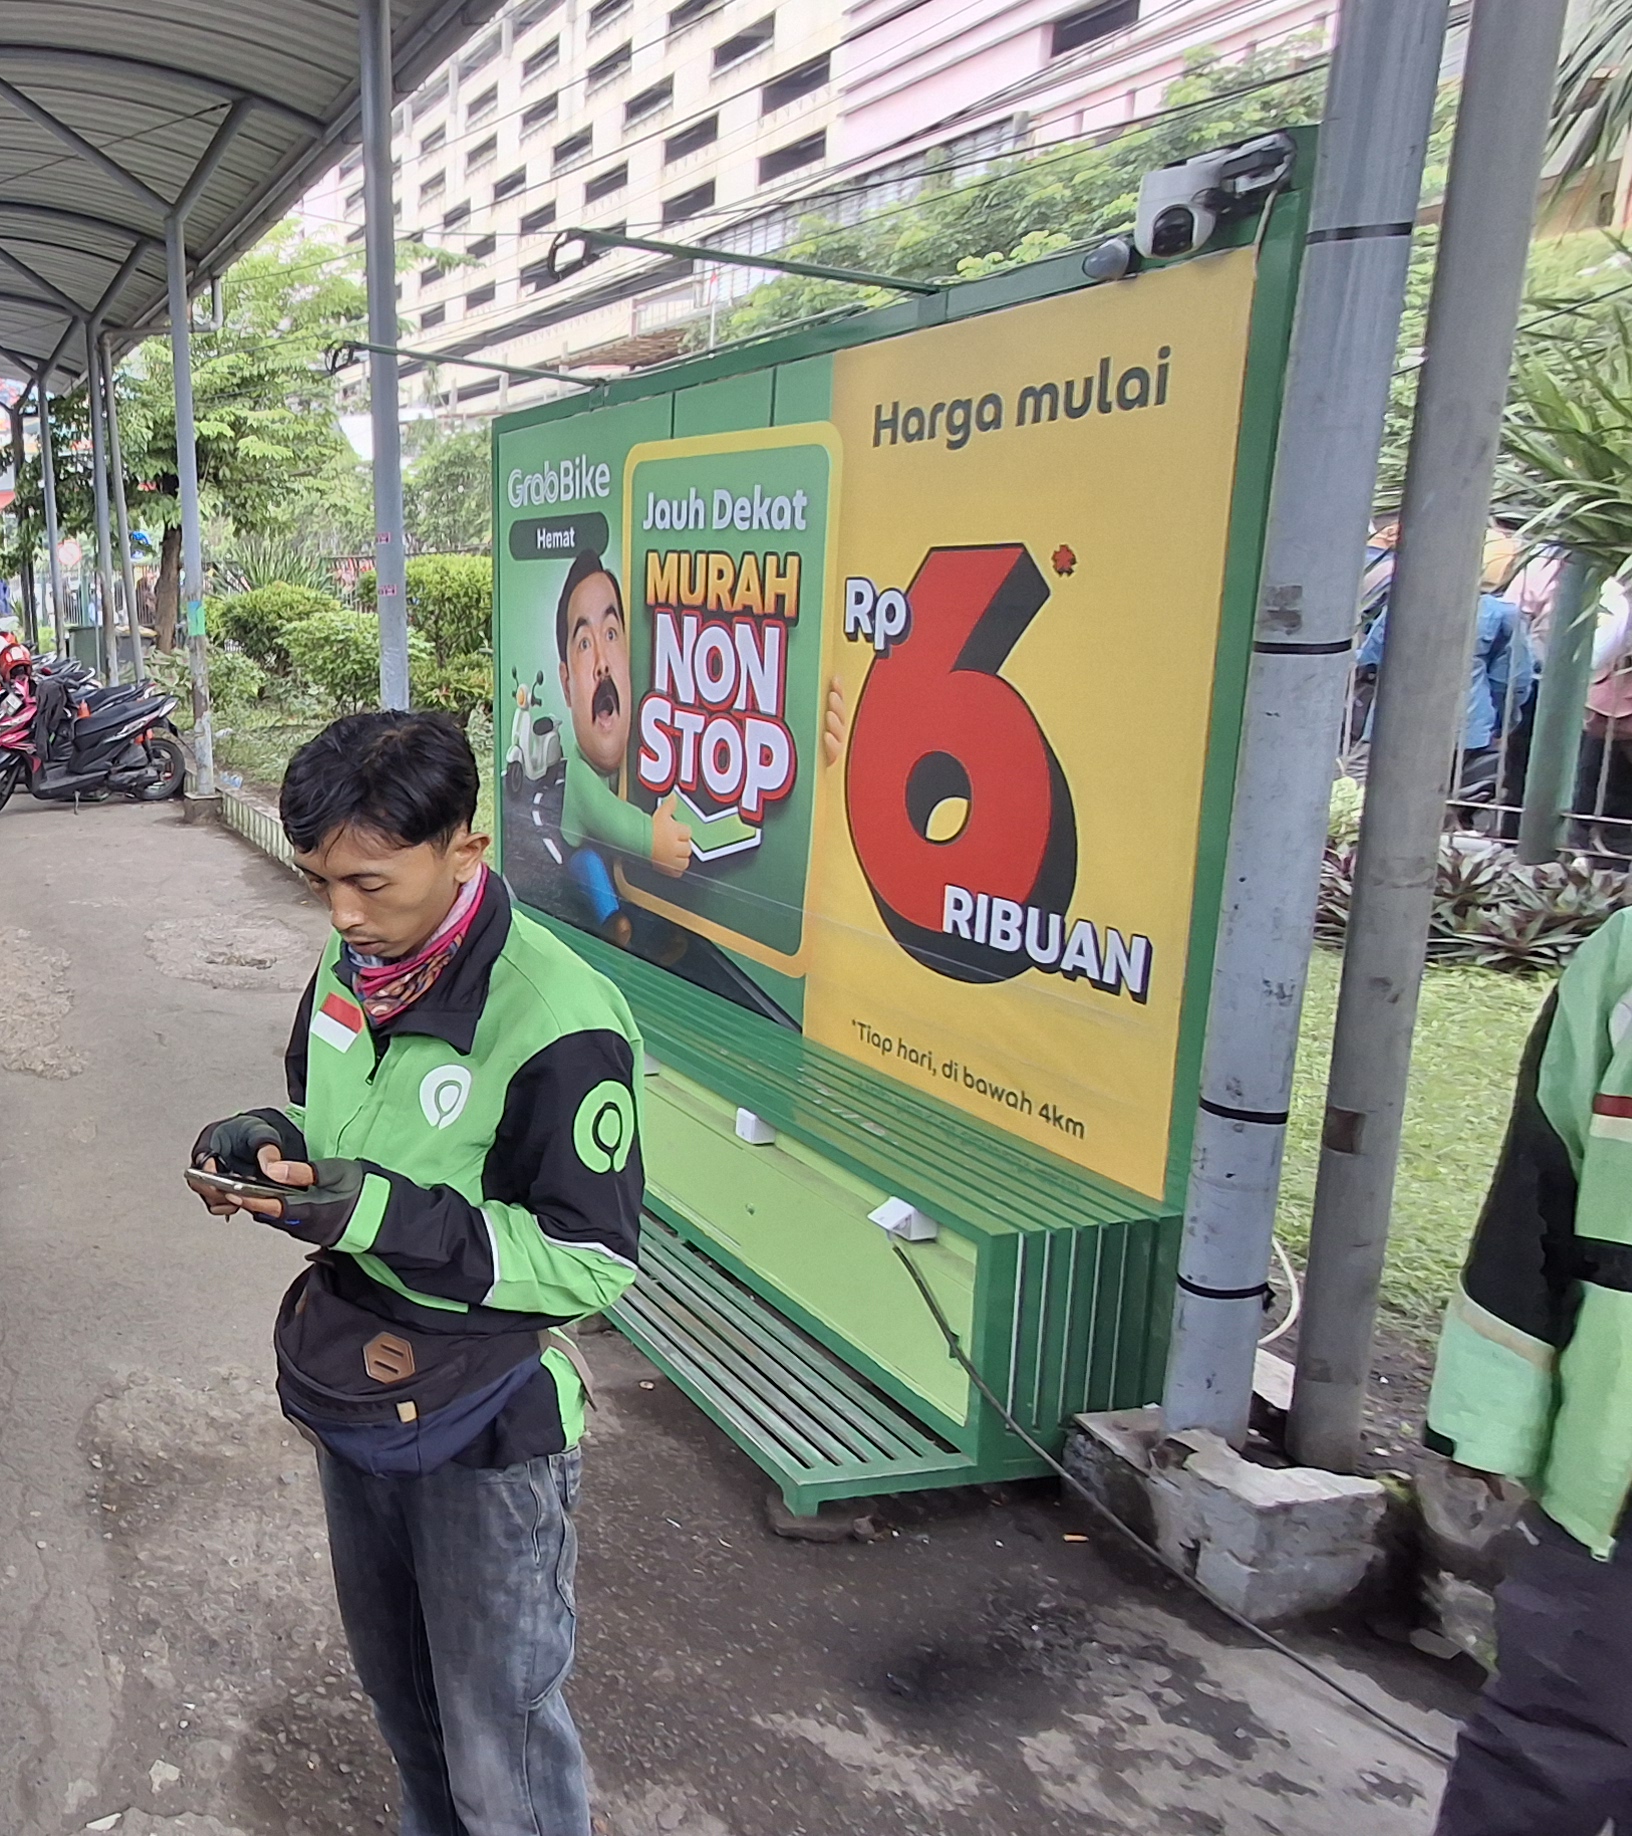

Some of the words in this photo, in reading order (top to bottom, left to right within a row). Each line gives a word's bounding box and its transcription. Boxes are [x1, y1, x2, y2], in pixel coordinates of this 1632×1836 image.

[872, 392, 1003, 451] Harga
[1015, 345, 1172, 428] mulai
[507, 454, 611, 509] GrabBike
[642, 487, 705, 531] Jauh
[712, 484, 808, 531] Dekat
[535, 526, 576, 550] Hemat
[646, 550, 801, 619] MURAH
[653, 611, 785, 717] NON
[844, 577, 910, 652] Rp
[638, 694, 794, 816] STOP
[847, 543, 1074, 981] 6
[942, 884, 1152, 1000] RIBUAN
[896, 1037, 938, 1076] hari,
[941, 1060, 959, 1083] di
[962, 1066, 1033, 1116] bawah
[1038, 1103, 1086, 1140] 4km
